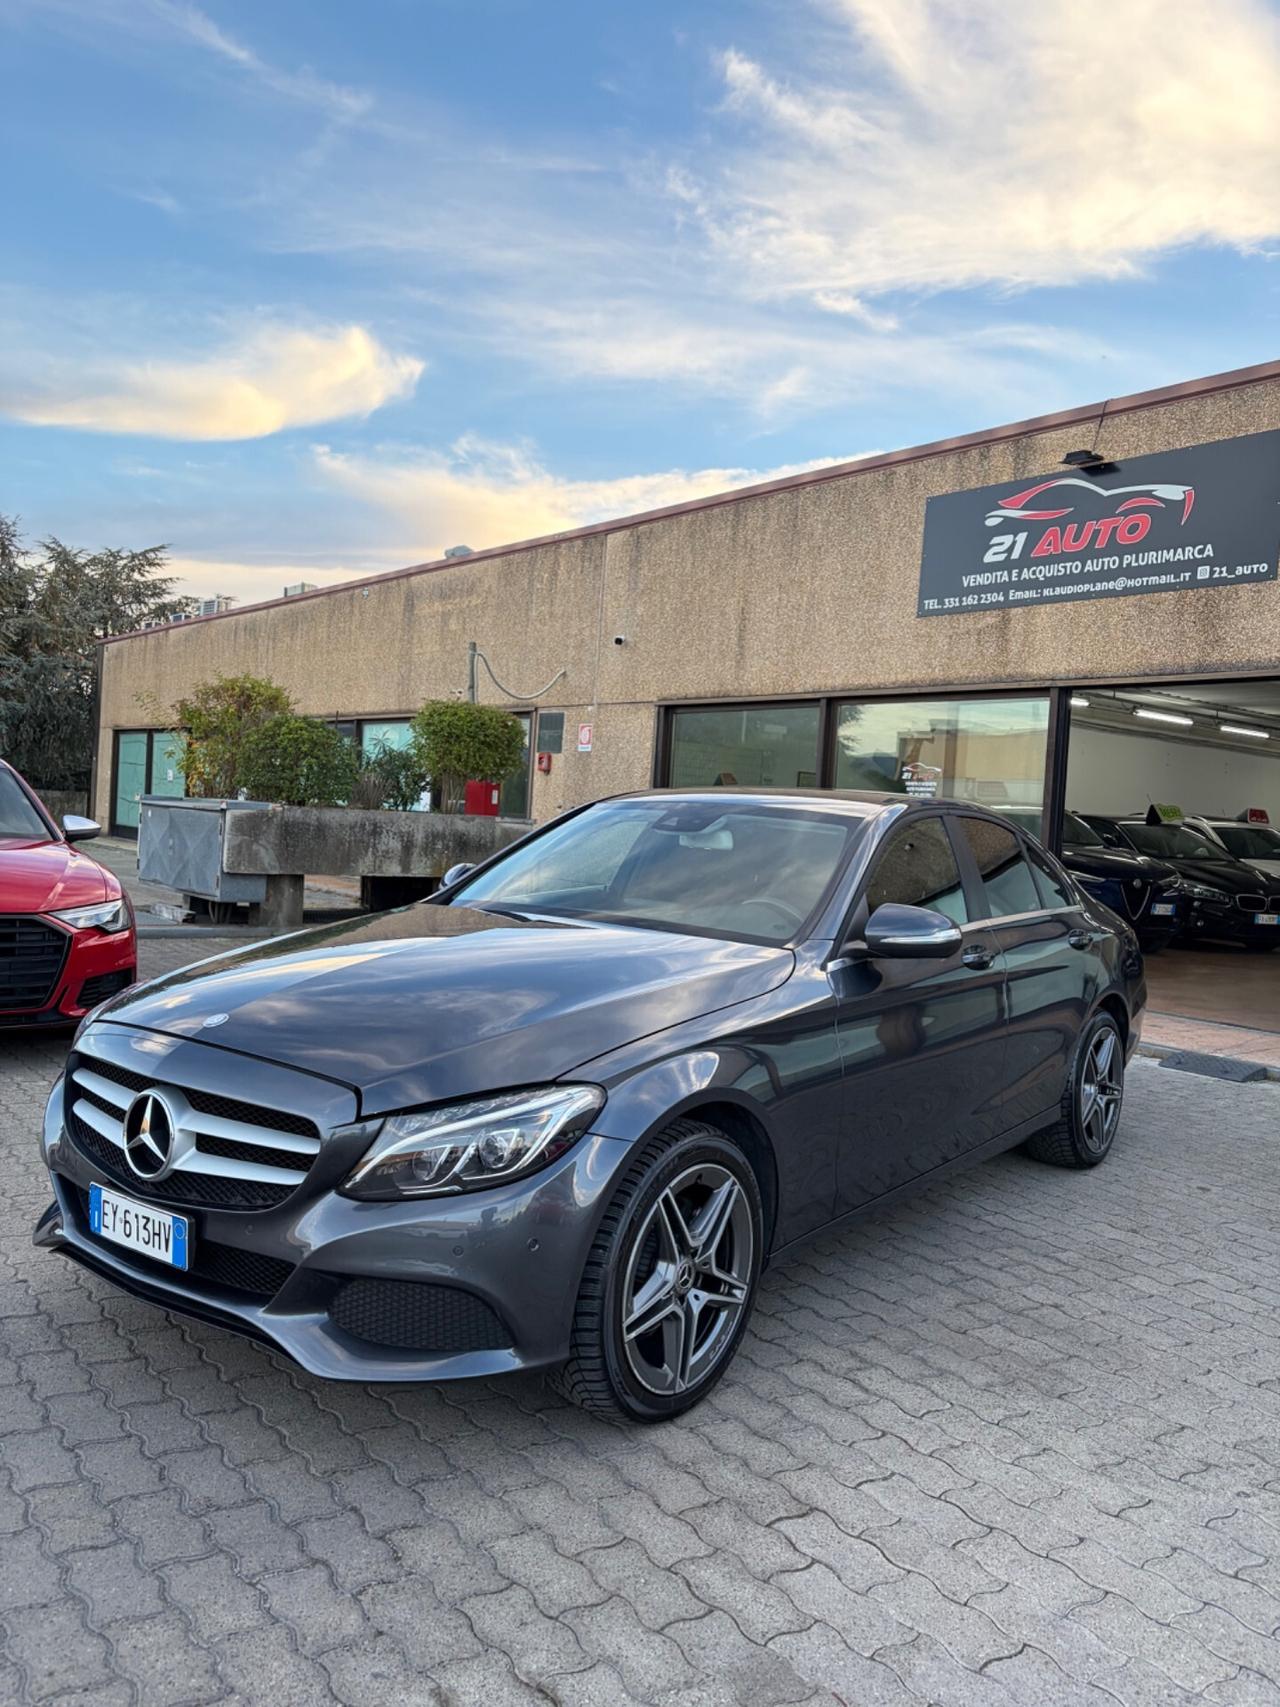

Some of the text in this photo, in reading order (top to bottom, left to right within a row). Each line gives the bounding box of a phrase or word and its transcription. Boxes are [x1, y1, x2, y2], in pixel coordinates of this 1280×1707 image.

[983, 513, 1151, 563] 21 AUTO
[962, 543, 1214, 588] VENDITA E ACQUISTO AUTO PLURIMARCA
[924, 599, 942, 610] TEL.
[943, 595, 960, 608] 331
[962, 594, 978, 606] 162
[980, 591, 1005, 604] 2304
